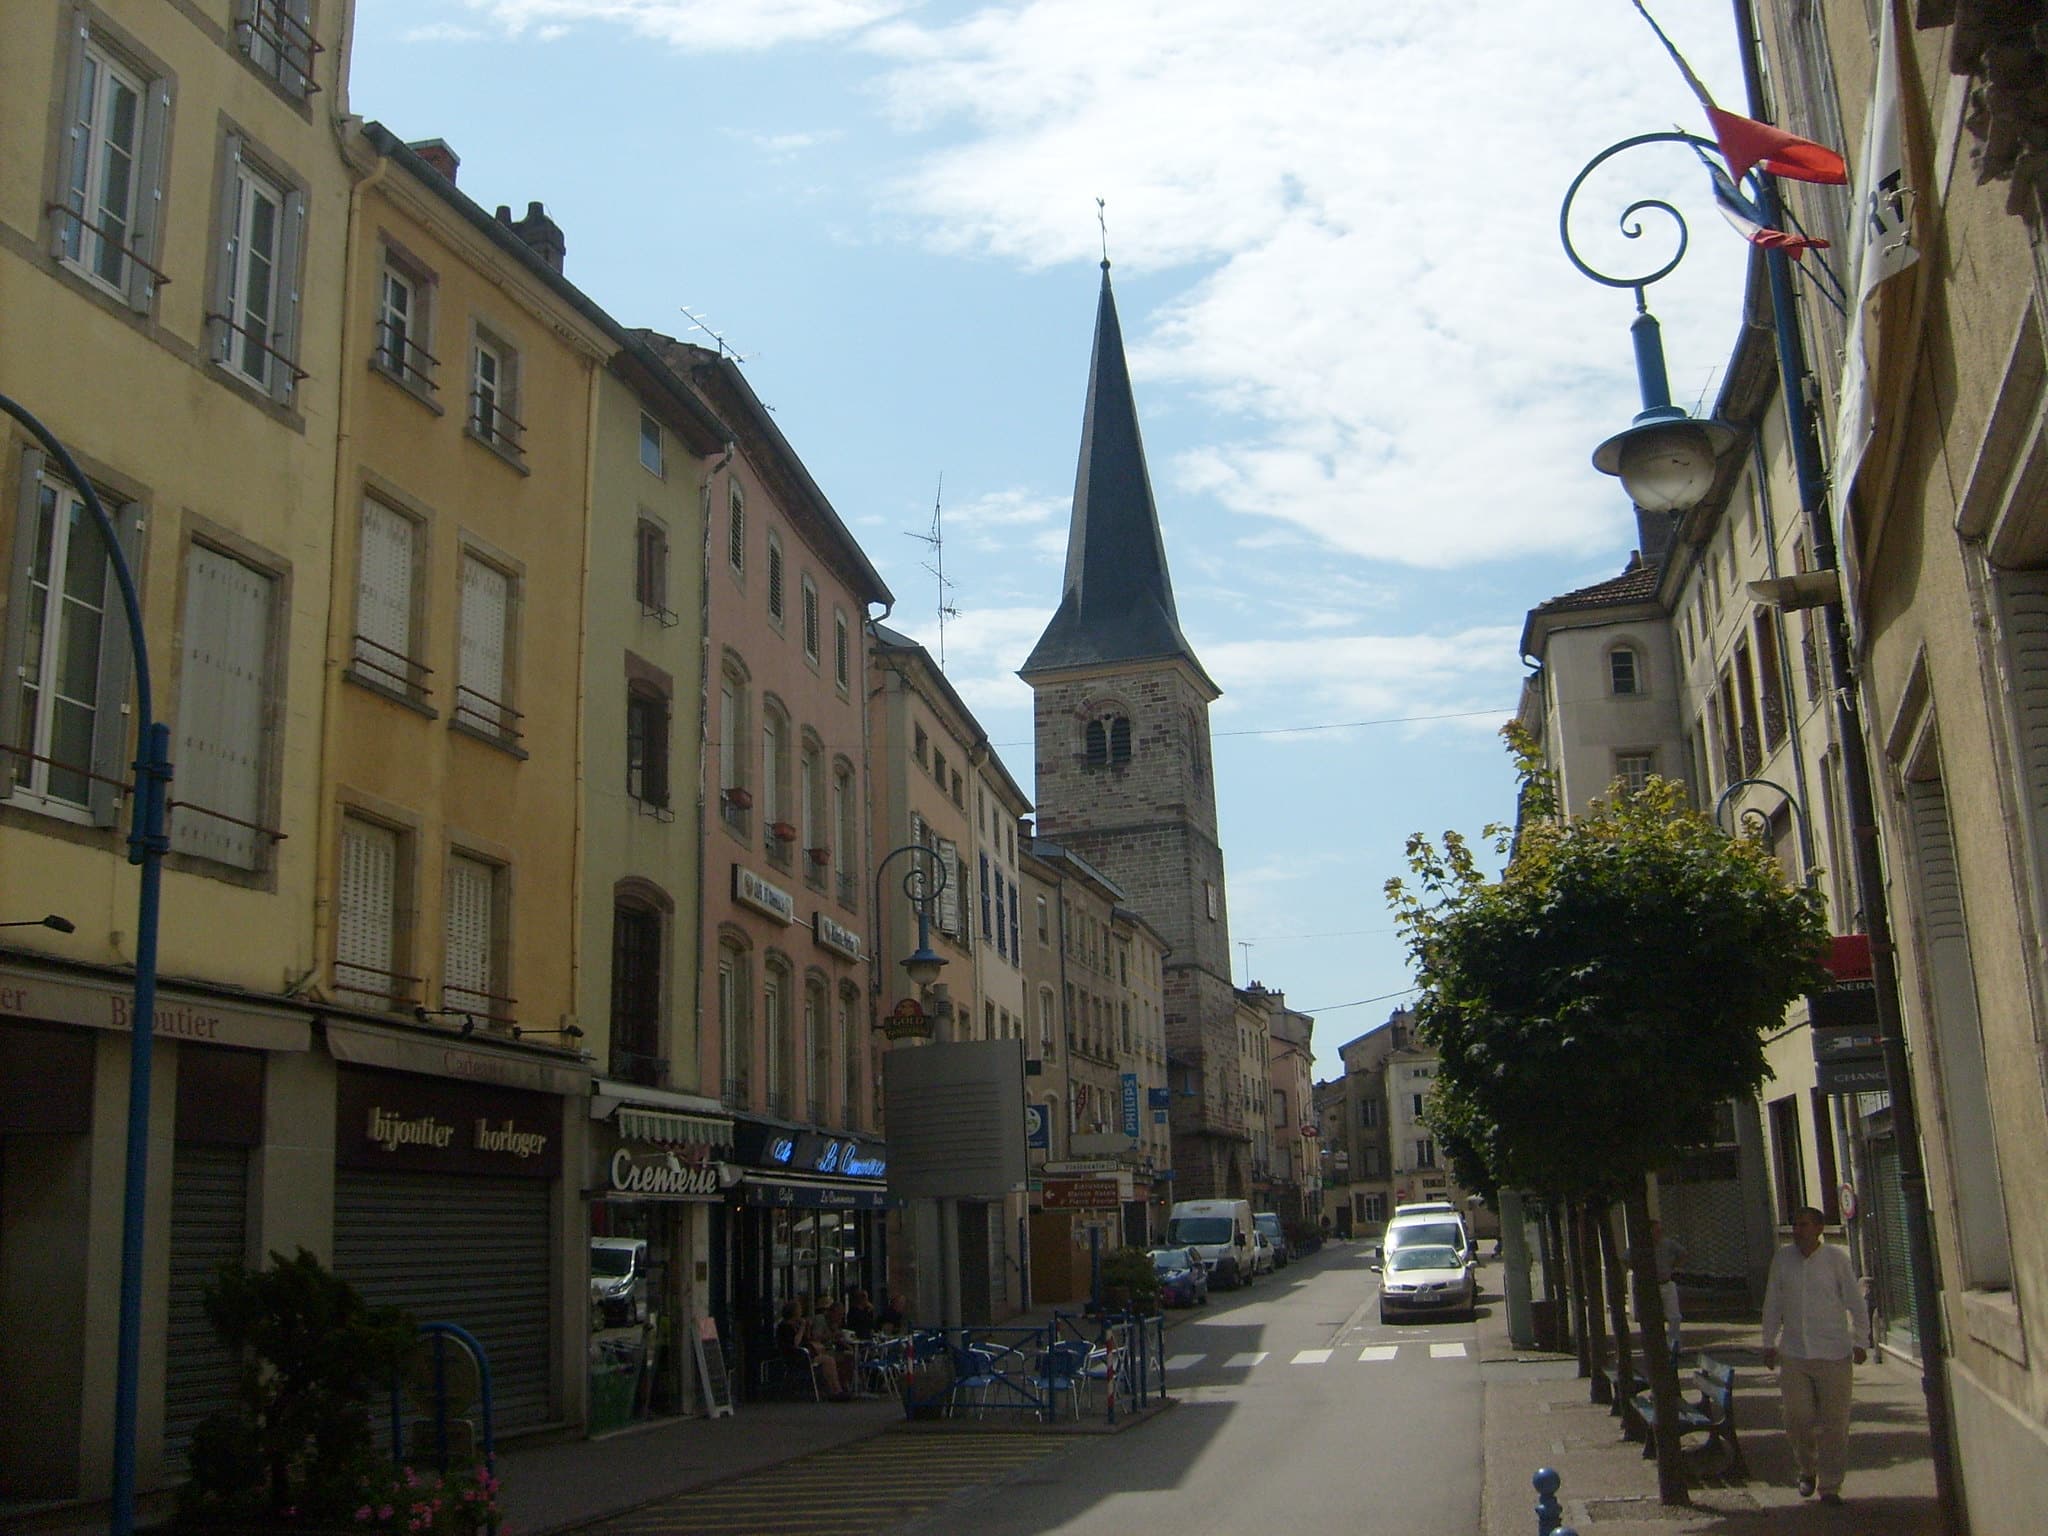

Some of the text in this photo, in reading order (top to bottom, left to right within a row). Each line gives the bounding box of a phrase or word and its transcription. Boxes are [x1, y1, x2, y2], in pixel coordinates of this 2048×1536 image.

[0, 985, 27, 1010] er
[111, 996, 219, 1039] Boutier
[1834, 1071, 1887, 1082] CHANG
[1125, 1079, 1136, 1131] PHILIPS
[373, 1106, 548, 1158] bijoutier horloger
